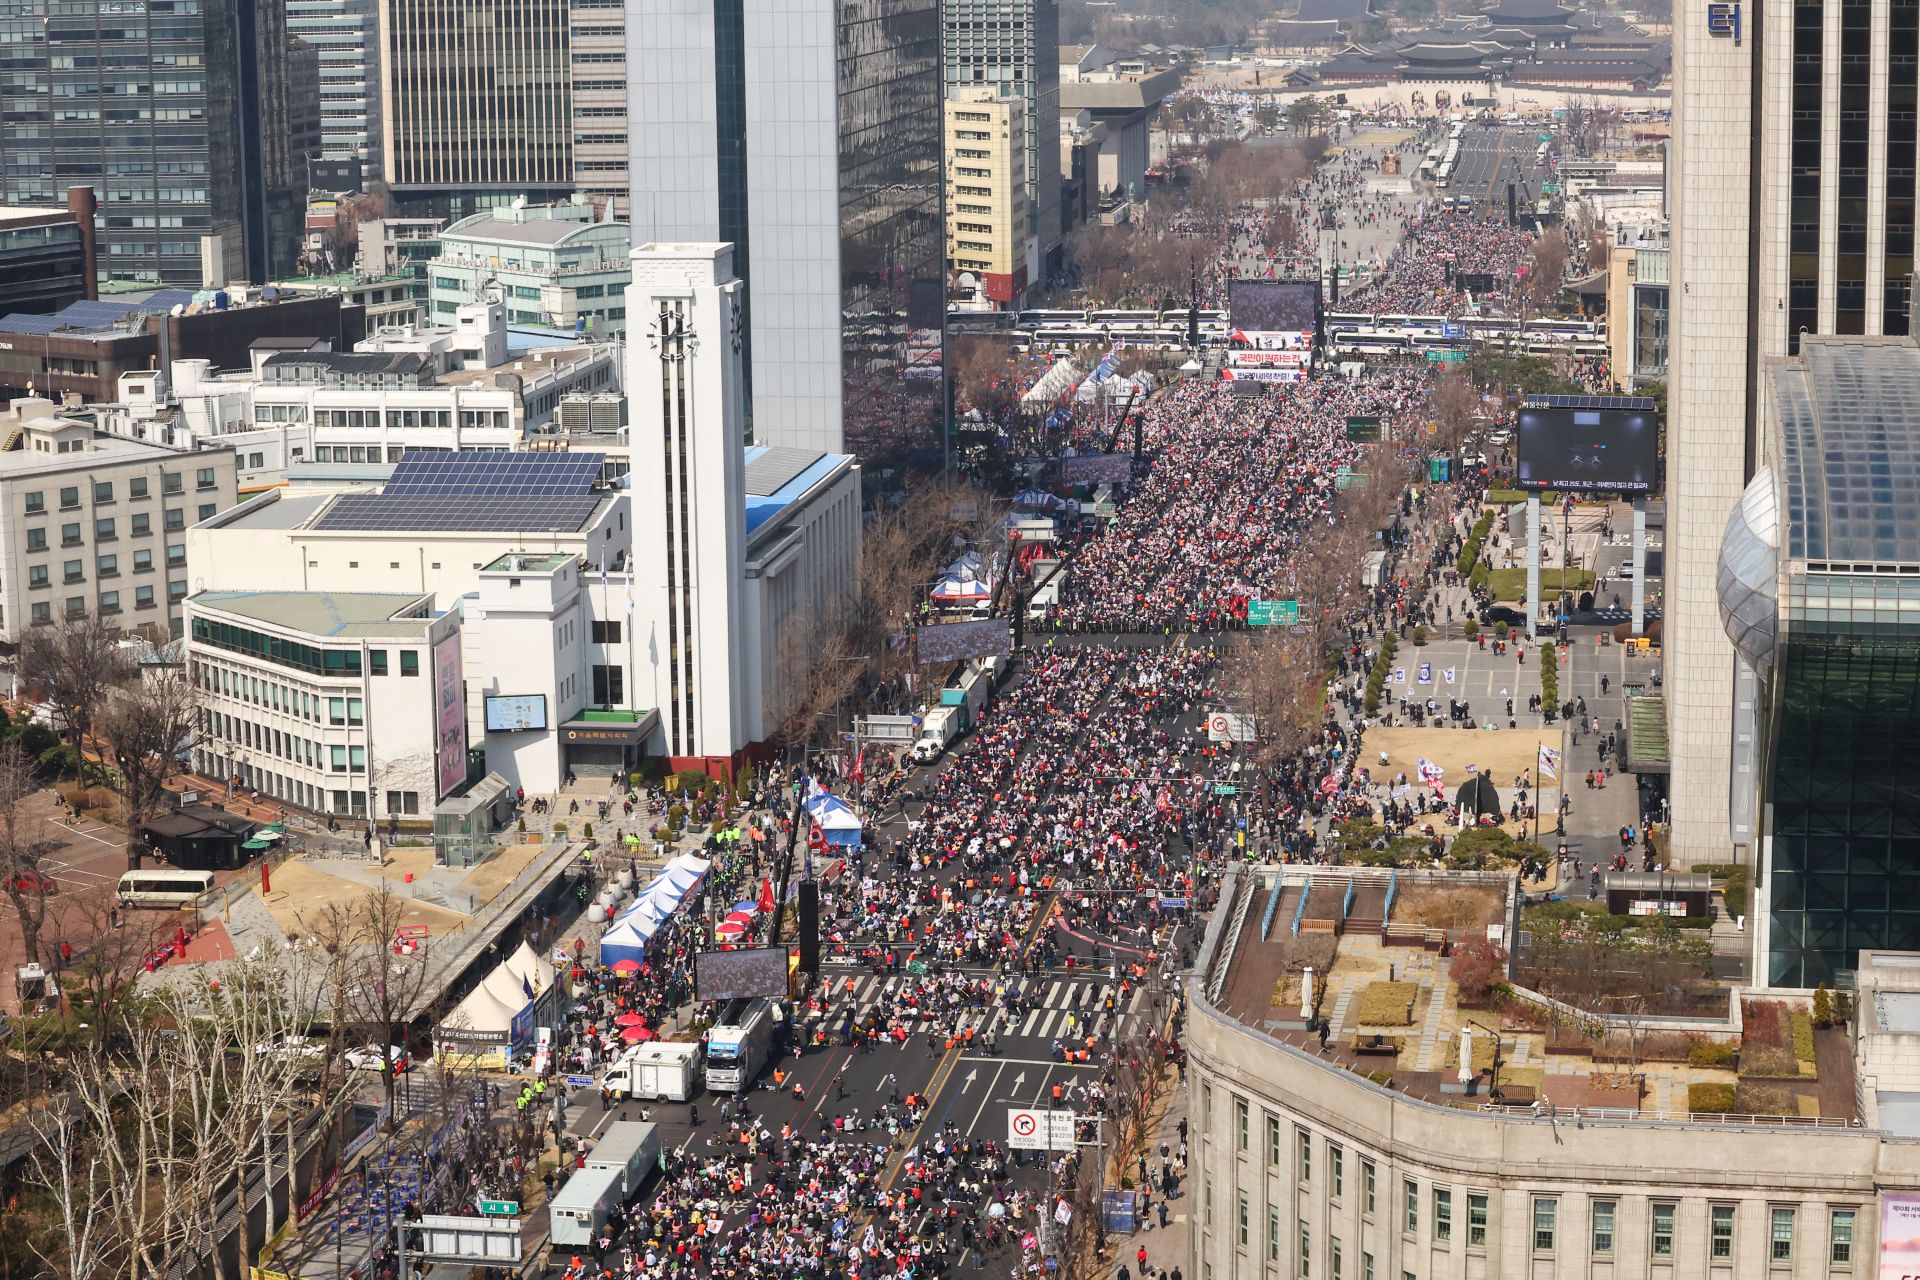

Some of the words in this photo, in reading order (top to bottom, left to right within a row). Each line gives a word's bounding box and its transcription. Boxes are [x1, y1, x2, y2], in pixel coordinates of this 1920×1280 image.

[1239, 353, 1263, 363] 국민이
[1265, 353, 1291, 363] 원하는
[300, 1199, 313, 1217] STOP
[314, 1189, 322, 1204] THE
